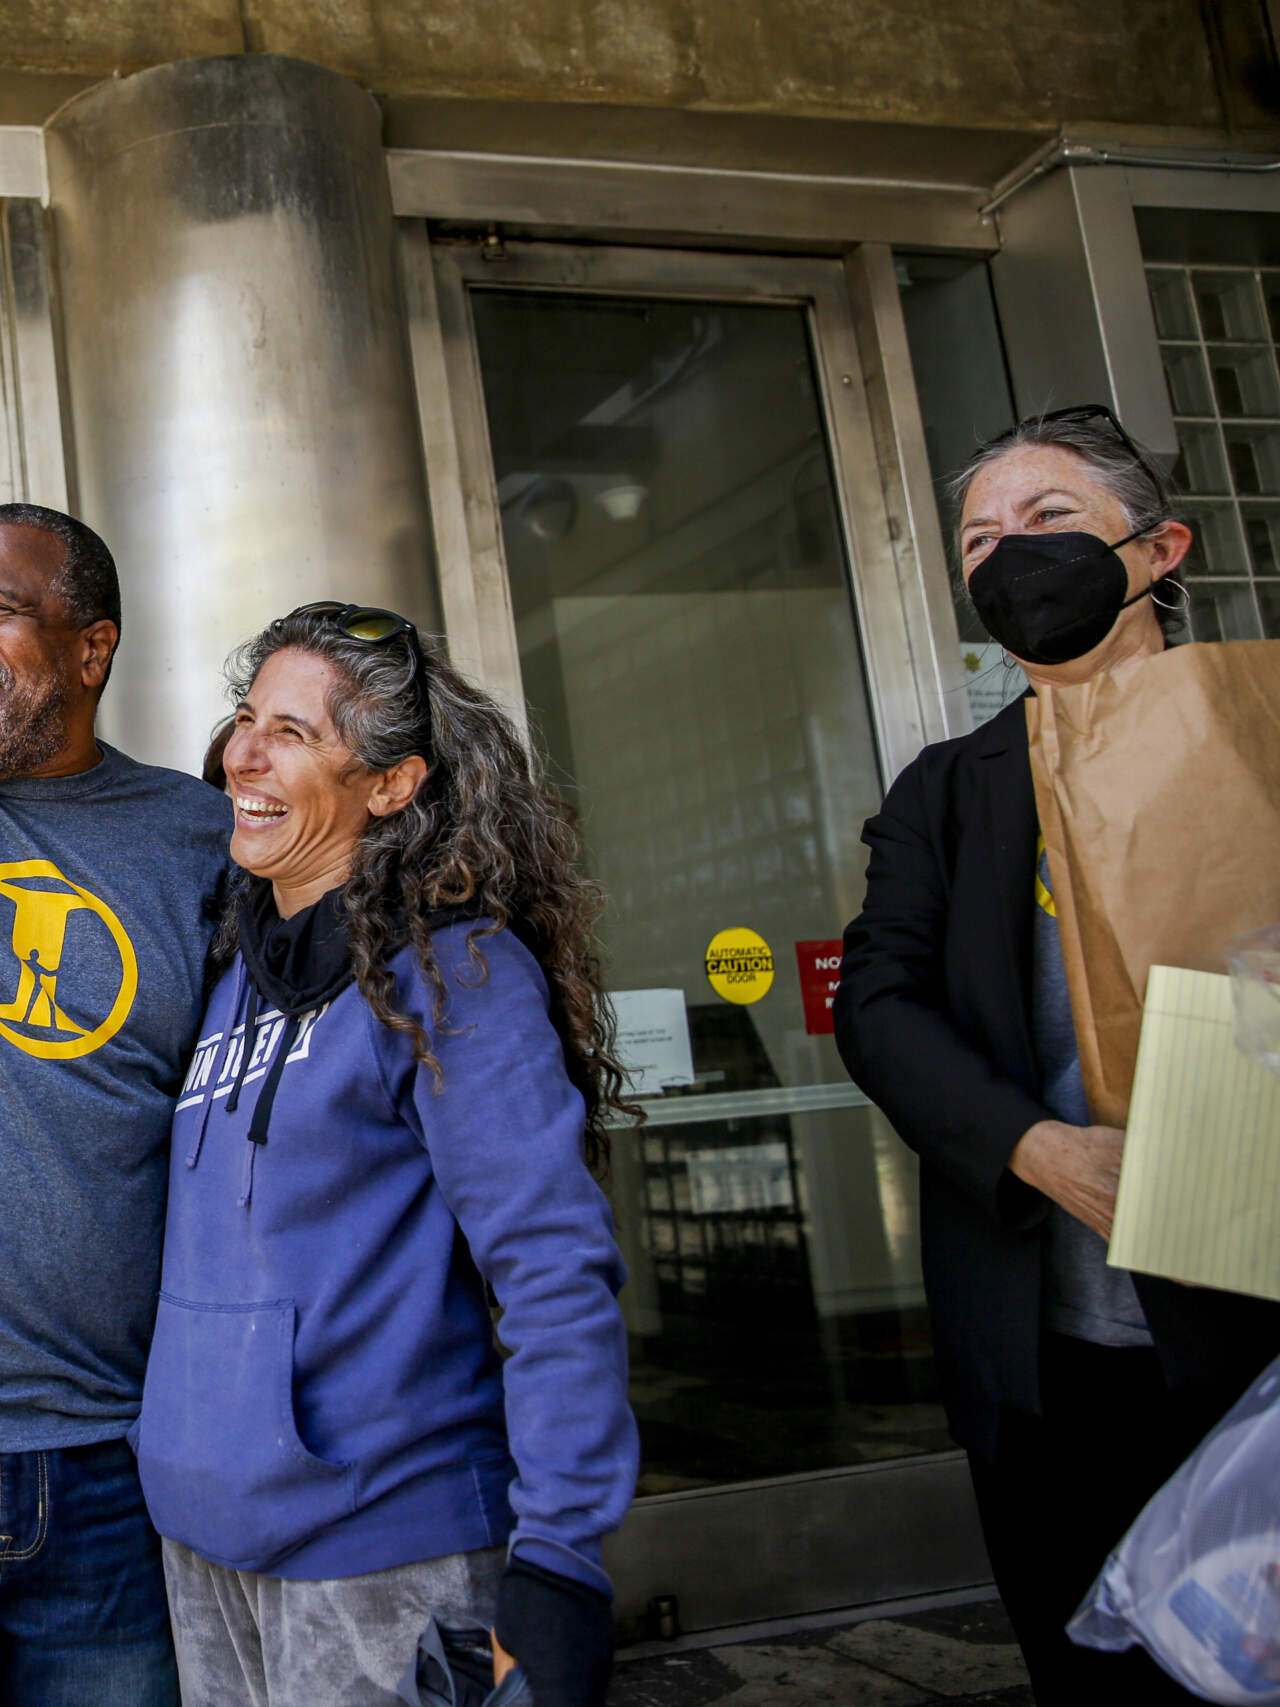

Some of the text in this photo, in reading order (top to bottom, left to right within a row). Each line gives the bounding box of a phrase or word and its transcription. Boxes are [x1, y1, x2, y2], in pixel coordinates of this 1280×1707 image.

[709, 946, 769, 957] AUTOMATIC
[706, 957, 773, 974] CAUTION
[815, 956, 842, 970] NO
[726, 973, 757, 984] DOOR
